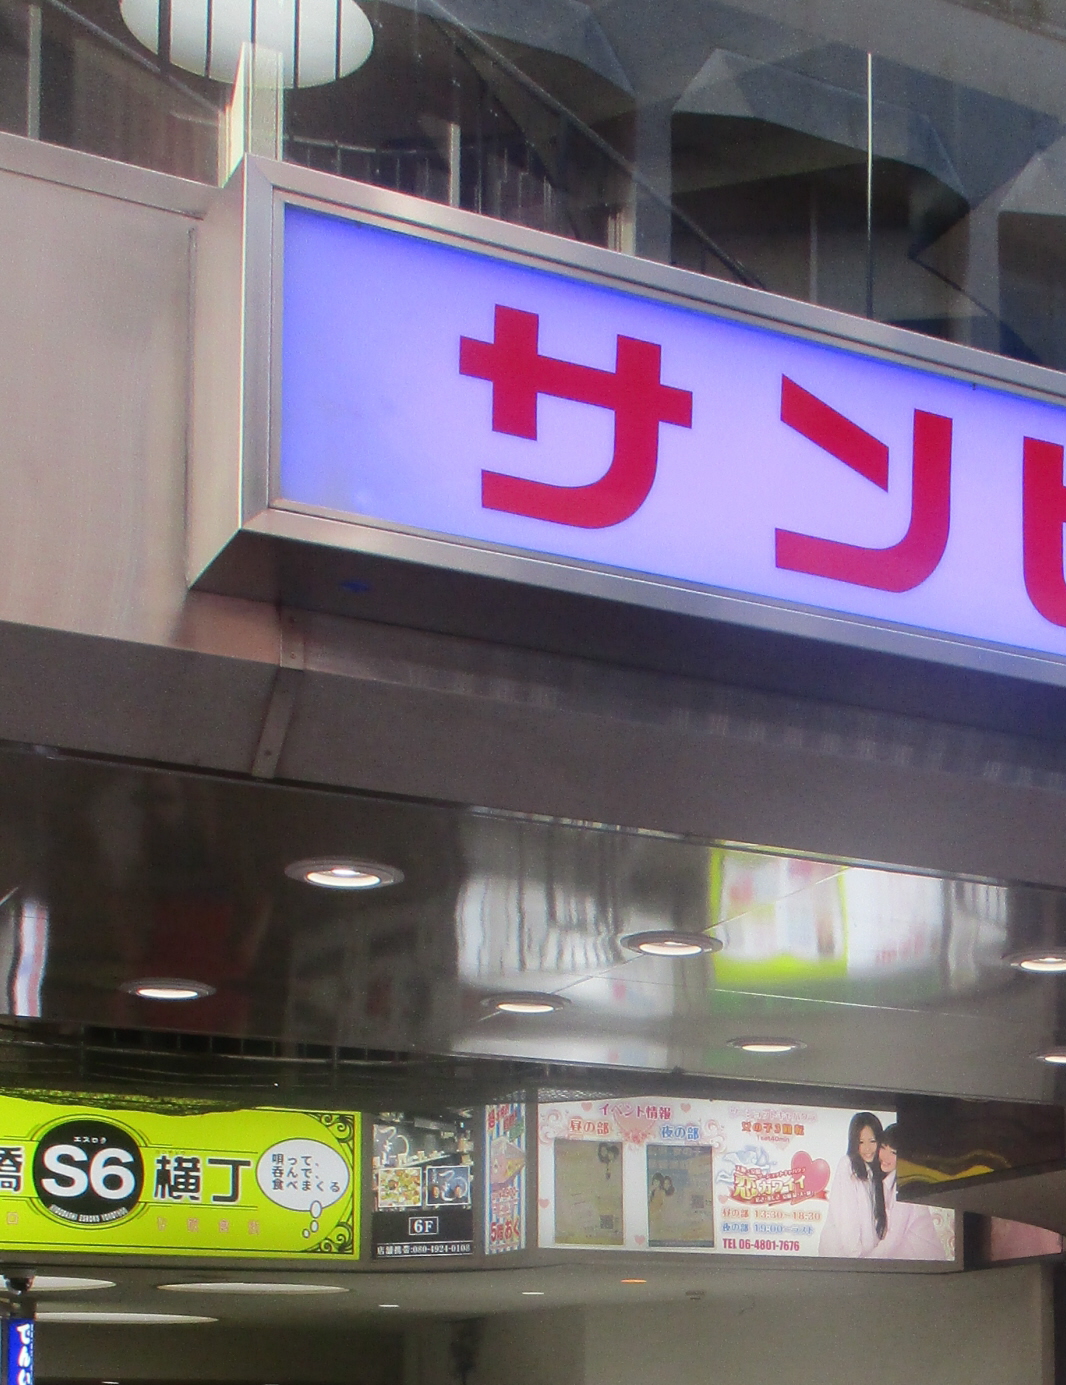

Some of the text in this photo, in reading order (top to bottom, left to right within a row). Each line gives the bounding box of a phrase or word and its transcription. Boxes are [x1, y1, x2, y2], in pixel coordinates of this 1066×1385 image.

[599, 1103, 671, 1120] イベント情報
[570, 1118, 611, 1136] 昼の部
[661, 1125, 700, 1140] 夜の部
[41, 1144, 136, 1200] S6
[154, 1154, 252, 1203] 横丁
[272, 1178, 341, 1192] 食べまくる
[722, 1208, 749, 1218] 昼の部
[413, 1219, 434, 1233] 6F
[722, 1223, 749, 1232] 夜の部
[723, 1238, 800, 1251] TEL 06-4801-7676
